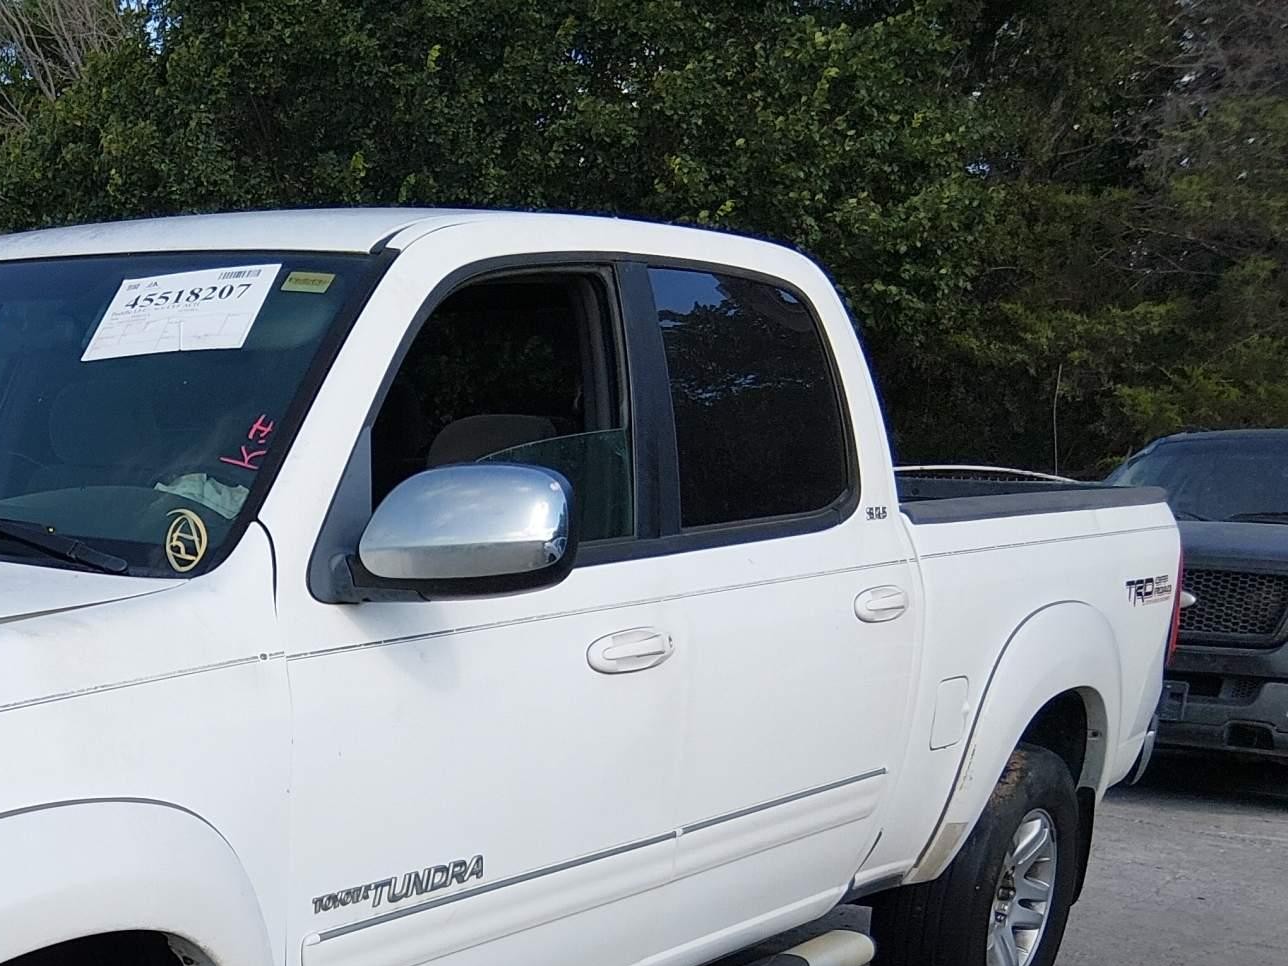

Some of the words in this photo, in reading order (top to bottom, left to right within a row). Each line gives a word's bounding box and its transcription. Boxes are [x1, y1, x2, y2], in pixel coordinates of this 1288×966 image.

[125, 284, 252, 309] 45518207
[1125, 577, 1155, 608] TRD
[312, 884, 373, 914] TOYOTA
[371, 854, 484, 908] TUNDRA
